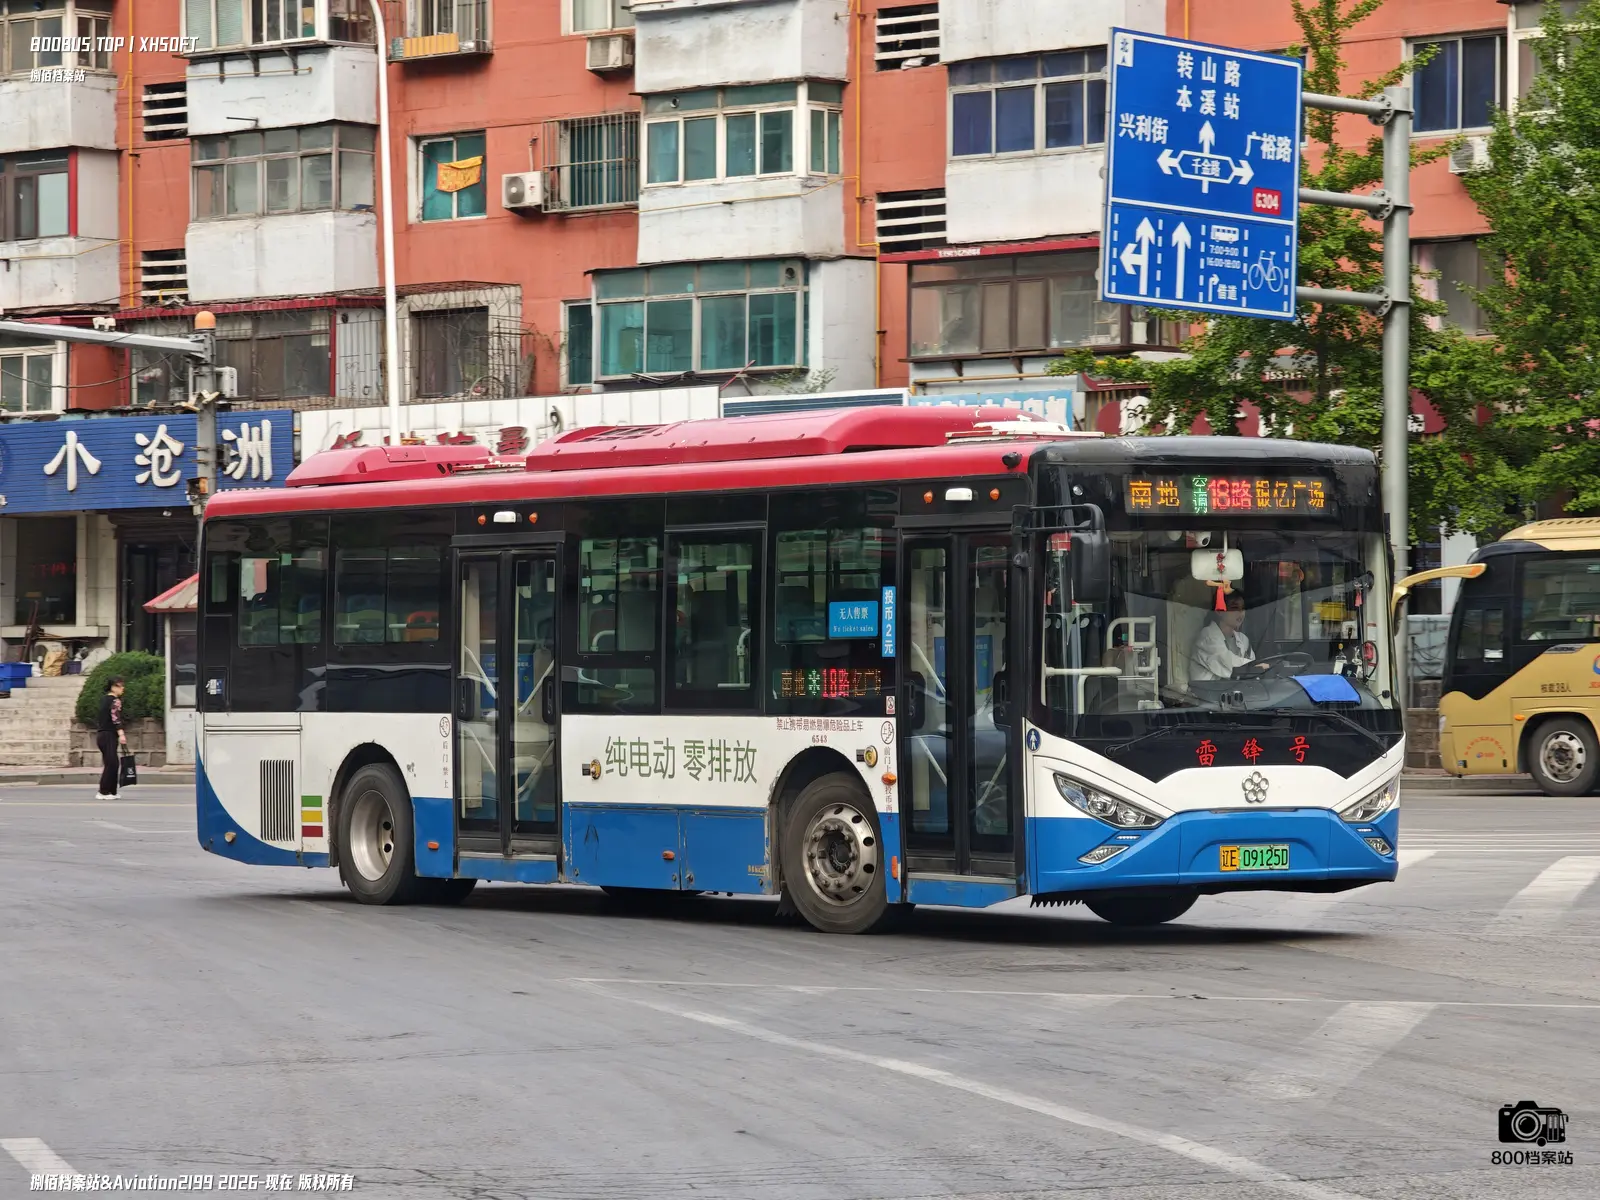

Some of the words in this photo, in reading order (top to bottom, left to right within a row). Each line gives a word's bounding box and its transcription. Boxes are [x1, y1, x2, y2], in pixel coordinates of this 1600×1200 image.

[1120, 38, 1129, 52] 北
[1177, 51, 1241, 88] 转山路
[1177, 85, 1240, 120] 本溪站
[1119, 112, 1169, 145] 兴利街
[1245, 131, 1293, 163] 广裕路
[1191, 158, 1221, 177] 千金路
[1255, 192, 1279, 210] G304
[44, 419, 273, 491] 小沧洲
[1129, 480, 1180, 509] 南地
[840, 607, 868, 620] 无人售票
[859, 624, 874, 632] sales
[885, 589, 894, 654] 投币2元
[822, 669, 850, 698] 18路
[605, 736, 676, 780] 纯电动
[683, 738, 757, 784] 零排放
[1195, 736, 1310, 766] 雷锋号
[1222, 850, 1237, 868] 辽E
[1243, 848, 1288, 867] 09125D
